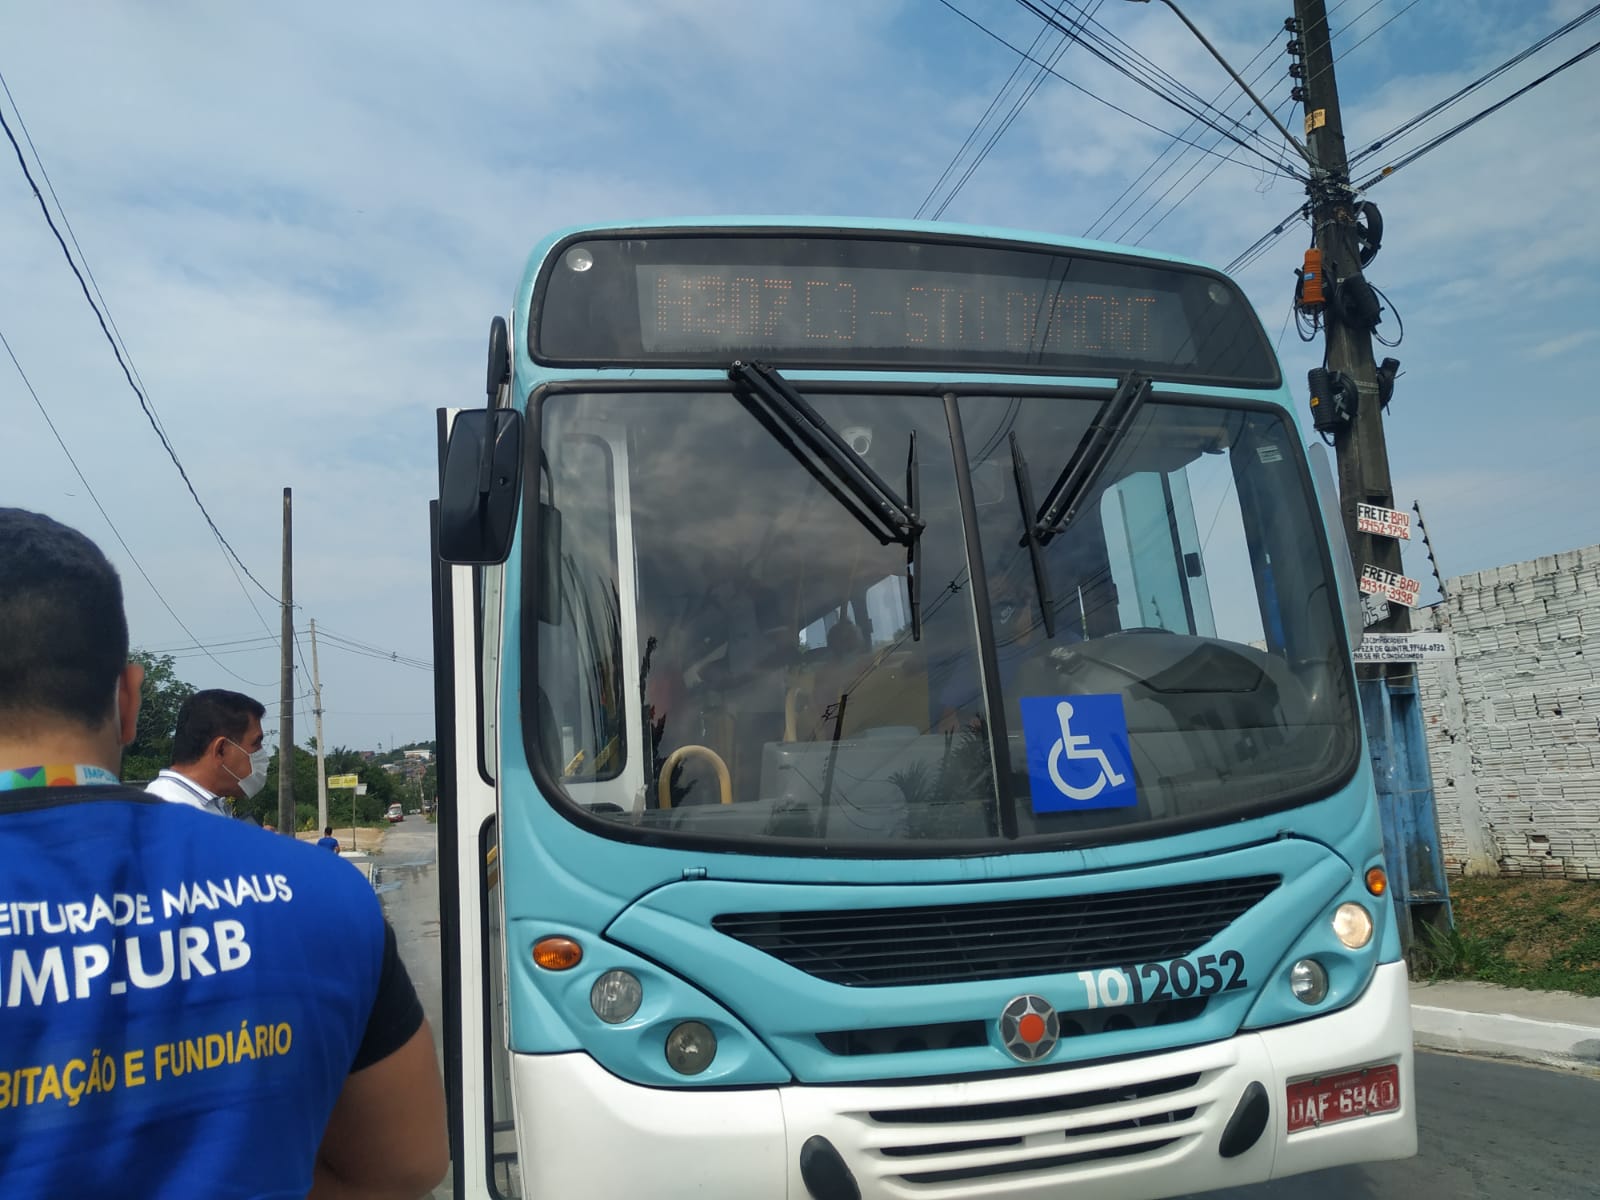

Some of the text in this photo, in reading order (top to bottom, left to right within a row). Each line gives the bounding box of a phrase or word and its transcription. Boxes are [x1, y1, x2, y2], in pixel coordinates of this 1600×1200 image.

[114, 893, 154, 927] DE
[162, 873, 293, 919] MANAUS
[124, 1050, 146, 1088] E
[154, 1019, 292, 1081] FUNDIÁRIO
